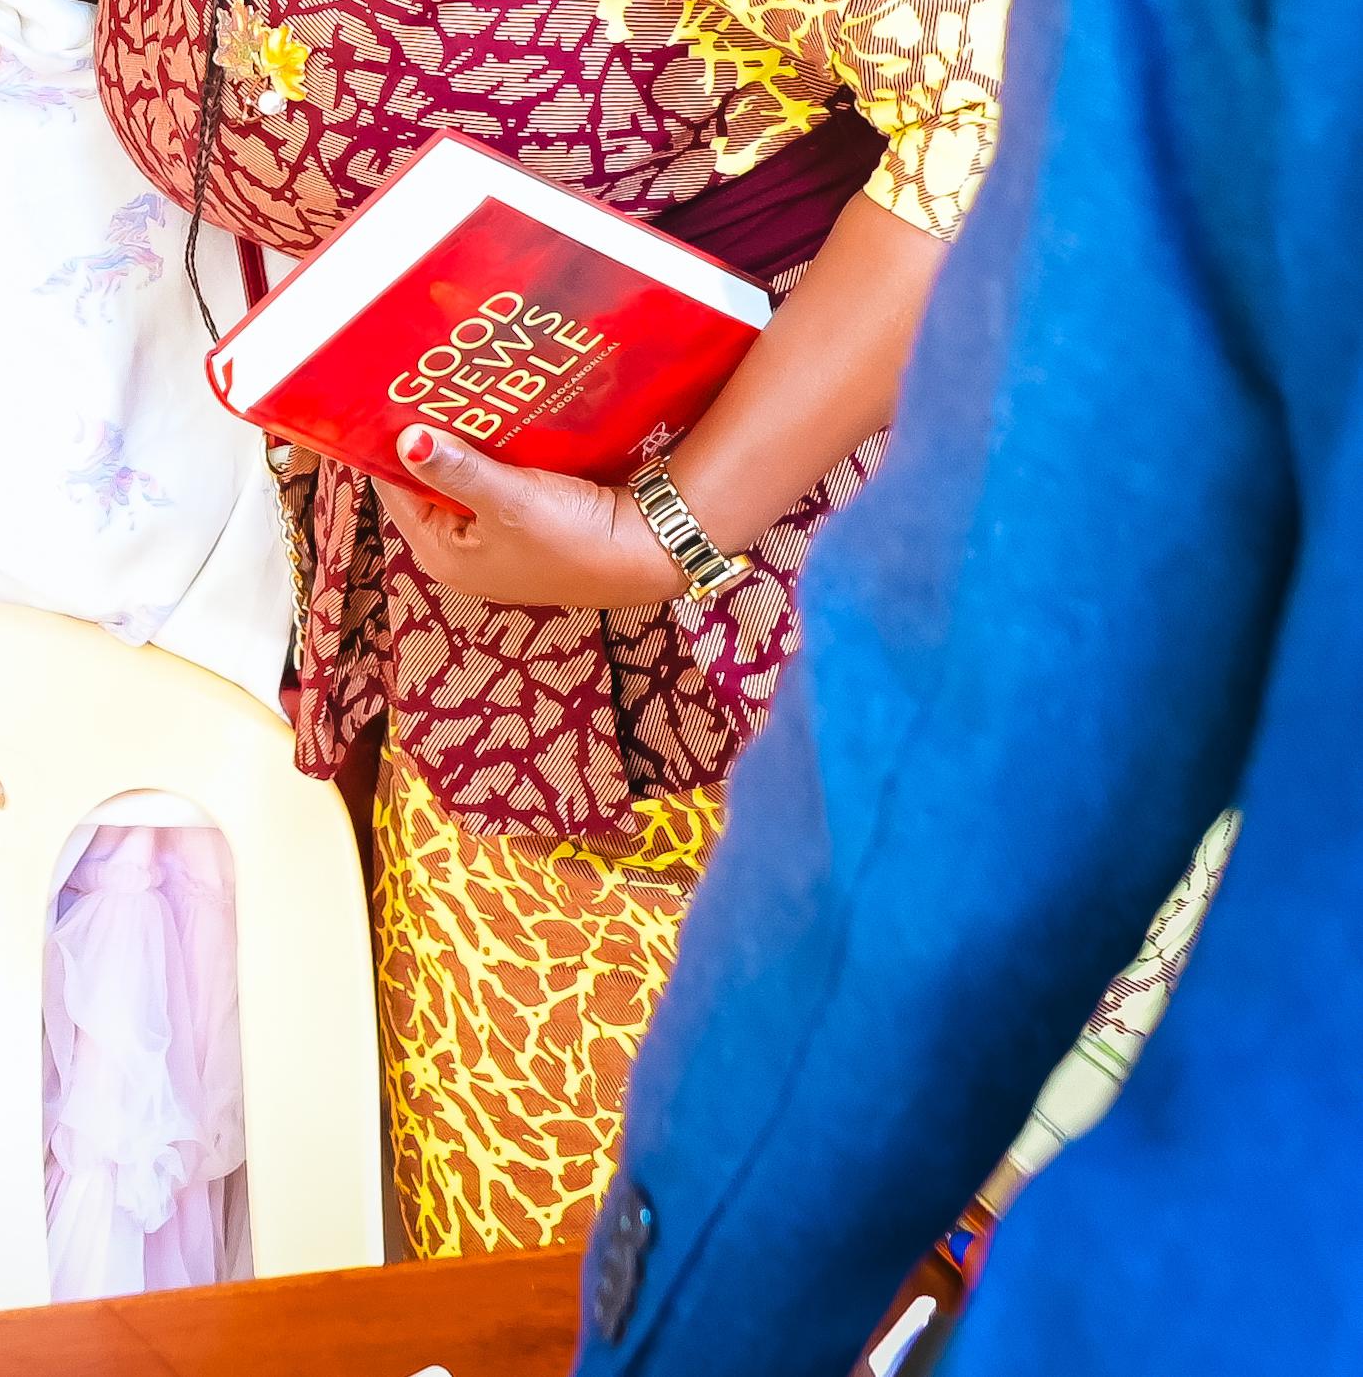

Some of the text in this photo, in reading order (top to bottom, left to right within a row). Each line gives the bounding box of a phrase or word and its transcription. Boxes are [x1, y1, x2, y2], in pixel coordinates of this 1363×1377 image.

[388, 291, 524, 403] GOOD
[417, 305, 563, 422] NEWS
[452, 320, 604, 441] BIBLE
[494, 342, 621, 448] WITH DEUTEROCANONICAL
[550, 385, 584, 414] BOOKS
